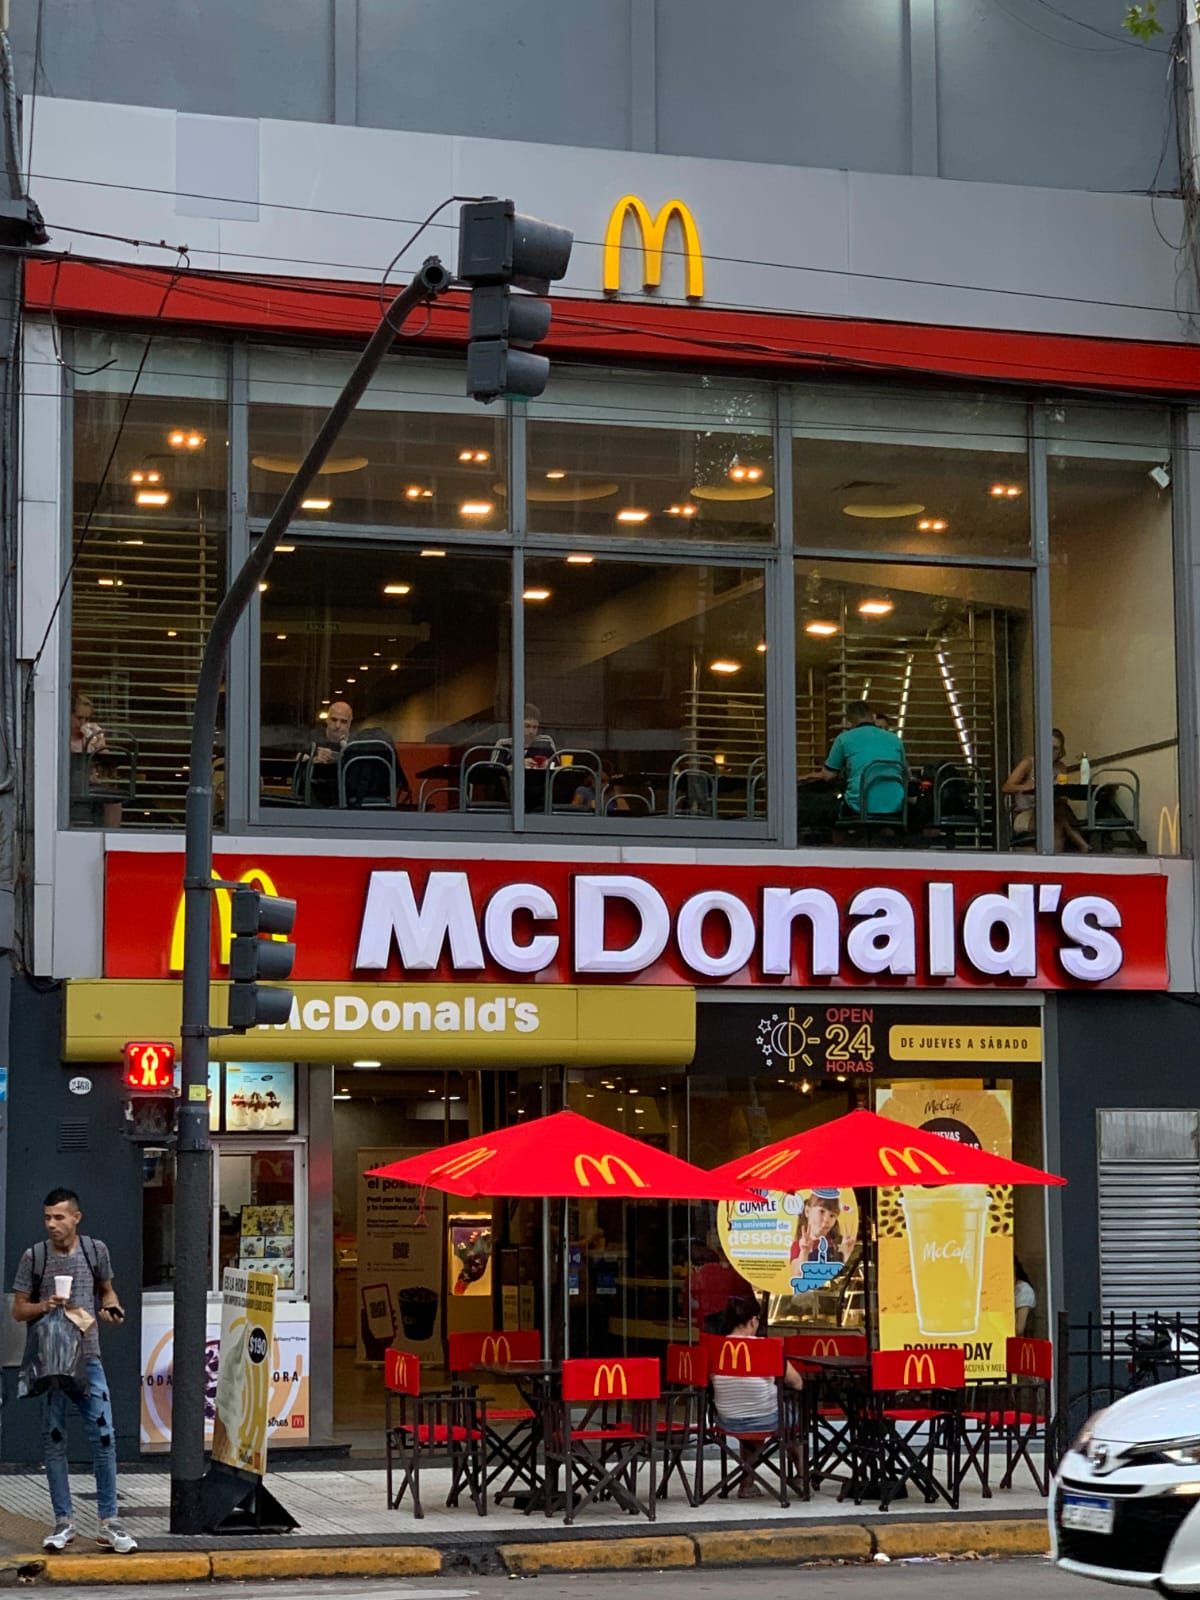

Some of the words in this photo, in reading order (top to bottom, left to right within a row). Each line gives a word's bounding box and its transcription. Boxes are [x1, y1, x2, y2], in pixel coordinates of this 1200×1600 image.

[355, 870, 1123, 981] McDonald's
[826, 1008, 874, 1023] OPEN
[825, 1024, 875, 1060] 24
[900, 1037, 914, 1048] DE
[919, 1037, 962, 1049] JUEVES
[967, 1038, 974, 1049] A
[980, 1036, 1029, 1050] SÁBADO
[826, 1061, 874, 1073] HORAS
[728, 1230, 793, 1246] deseos
[249, 1336, 266, 1356] $190
[963, 1342, 993, 1361] DAY
[273, 1371, 299, 1383] ORA
[268, 1417, 289, 1427] stres
